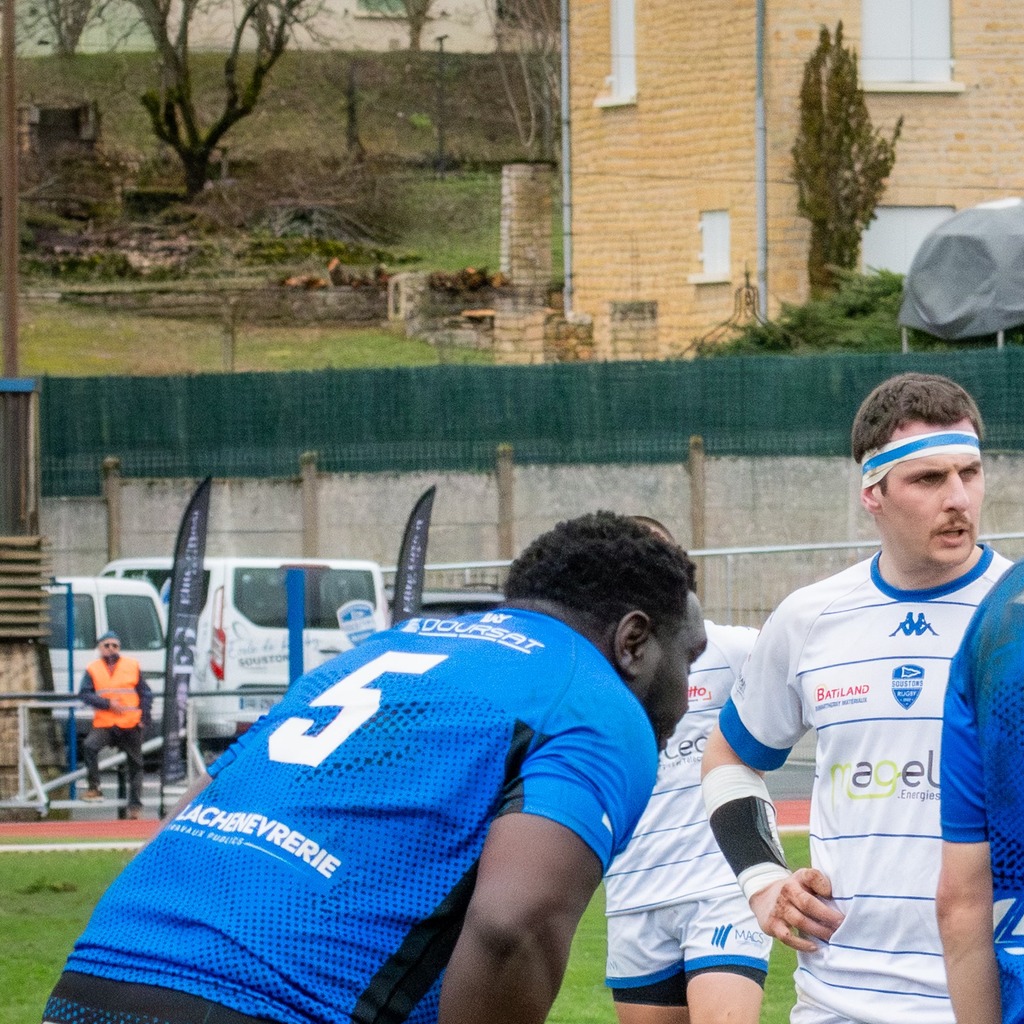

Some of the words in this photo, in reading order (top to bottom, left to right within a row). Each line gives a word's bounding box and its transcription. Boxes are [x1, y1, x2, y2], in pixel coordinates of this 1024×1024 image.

[421, 618, 545, 648] DOURSAT
[892, 680, 923, 688] SOUSTONS
[268, 650, 449, 768] 5
[735, 929, 764, 945] MACS
